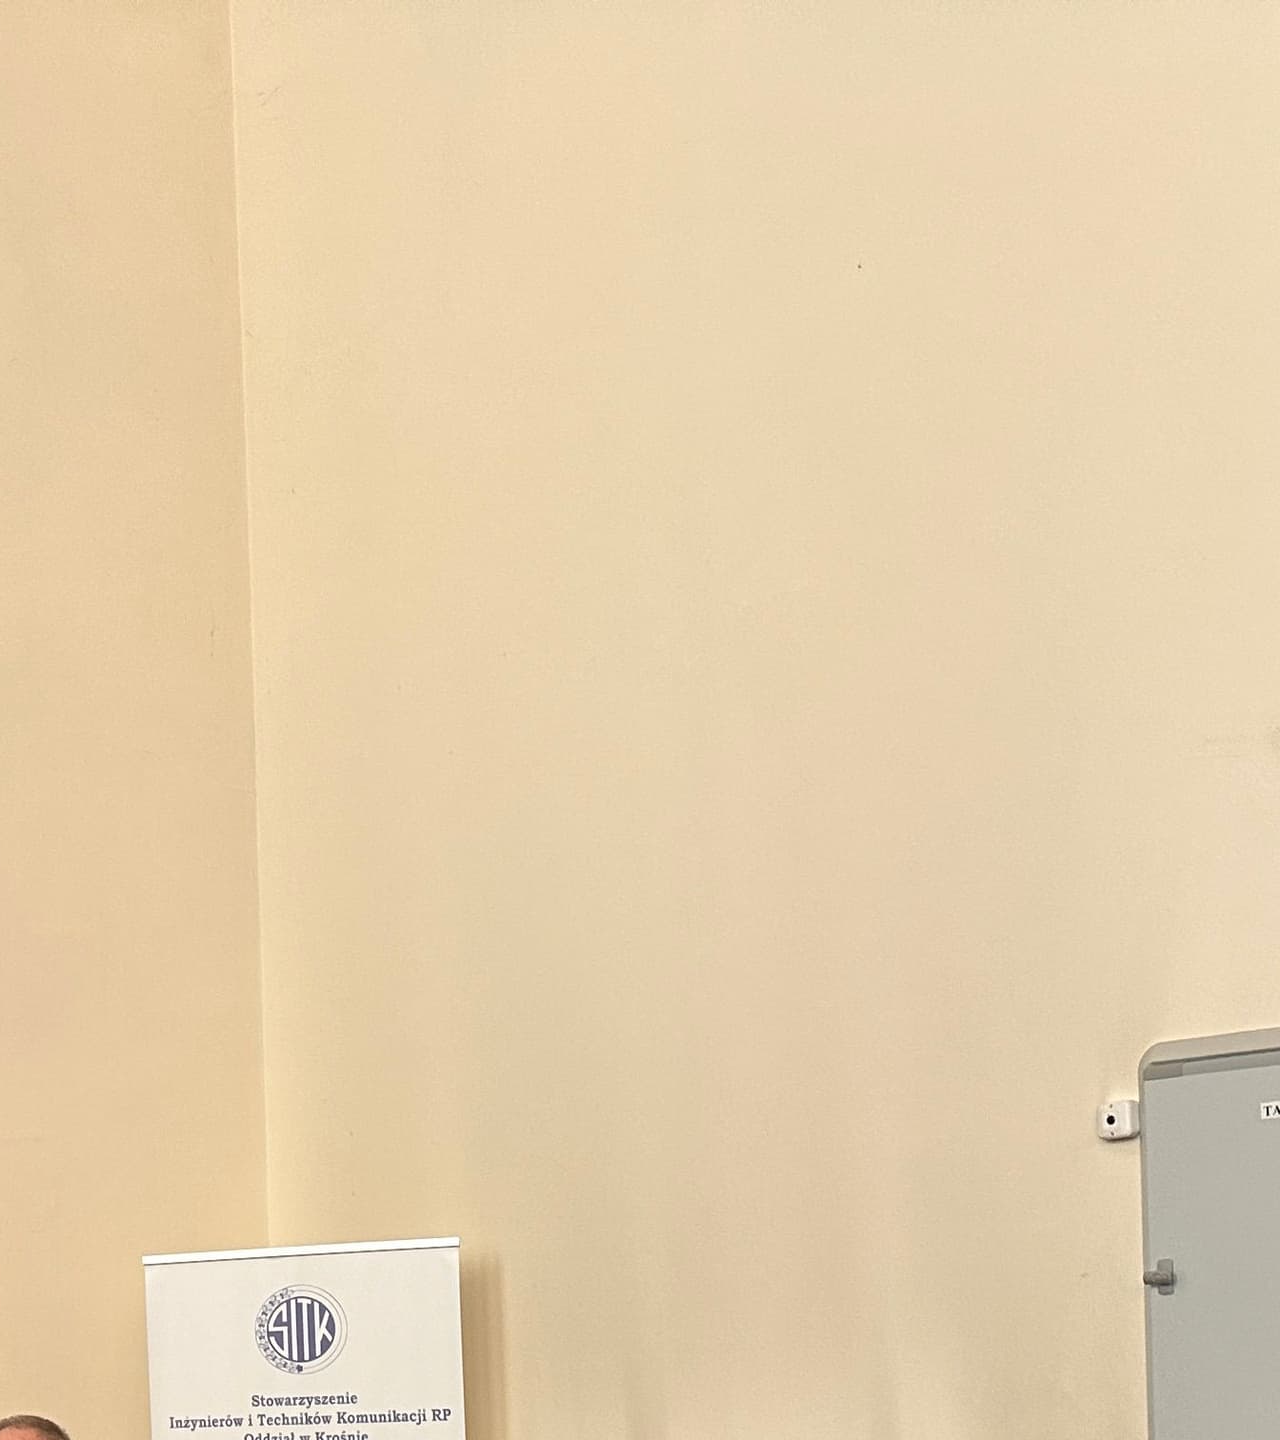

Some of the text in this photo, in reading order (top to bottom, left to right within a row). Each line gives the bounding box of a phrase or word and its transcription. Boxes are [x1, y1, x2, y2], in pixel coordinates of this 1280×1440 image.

[268, 1298, 335, 1361] SITK
[251, 1392, 358, 1409] Stowarzyszenie
[169, 1408, 452, 1431] Inżynierów i Techników Komunikacji RP
